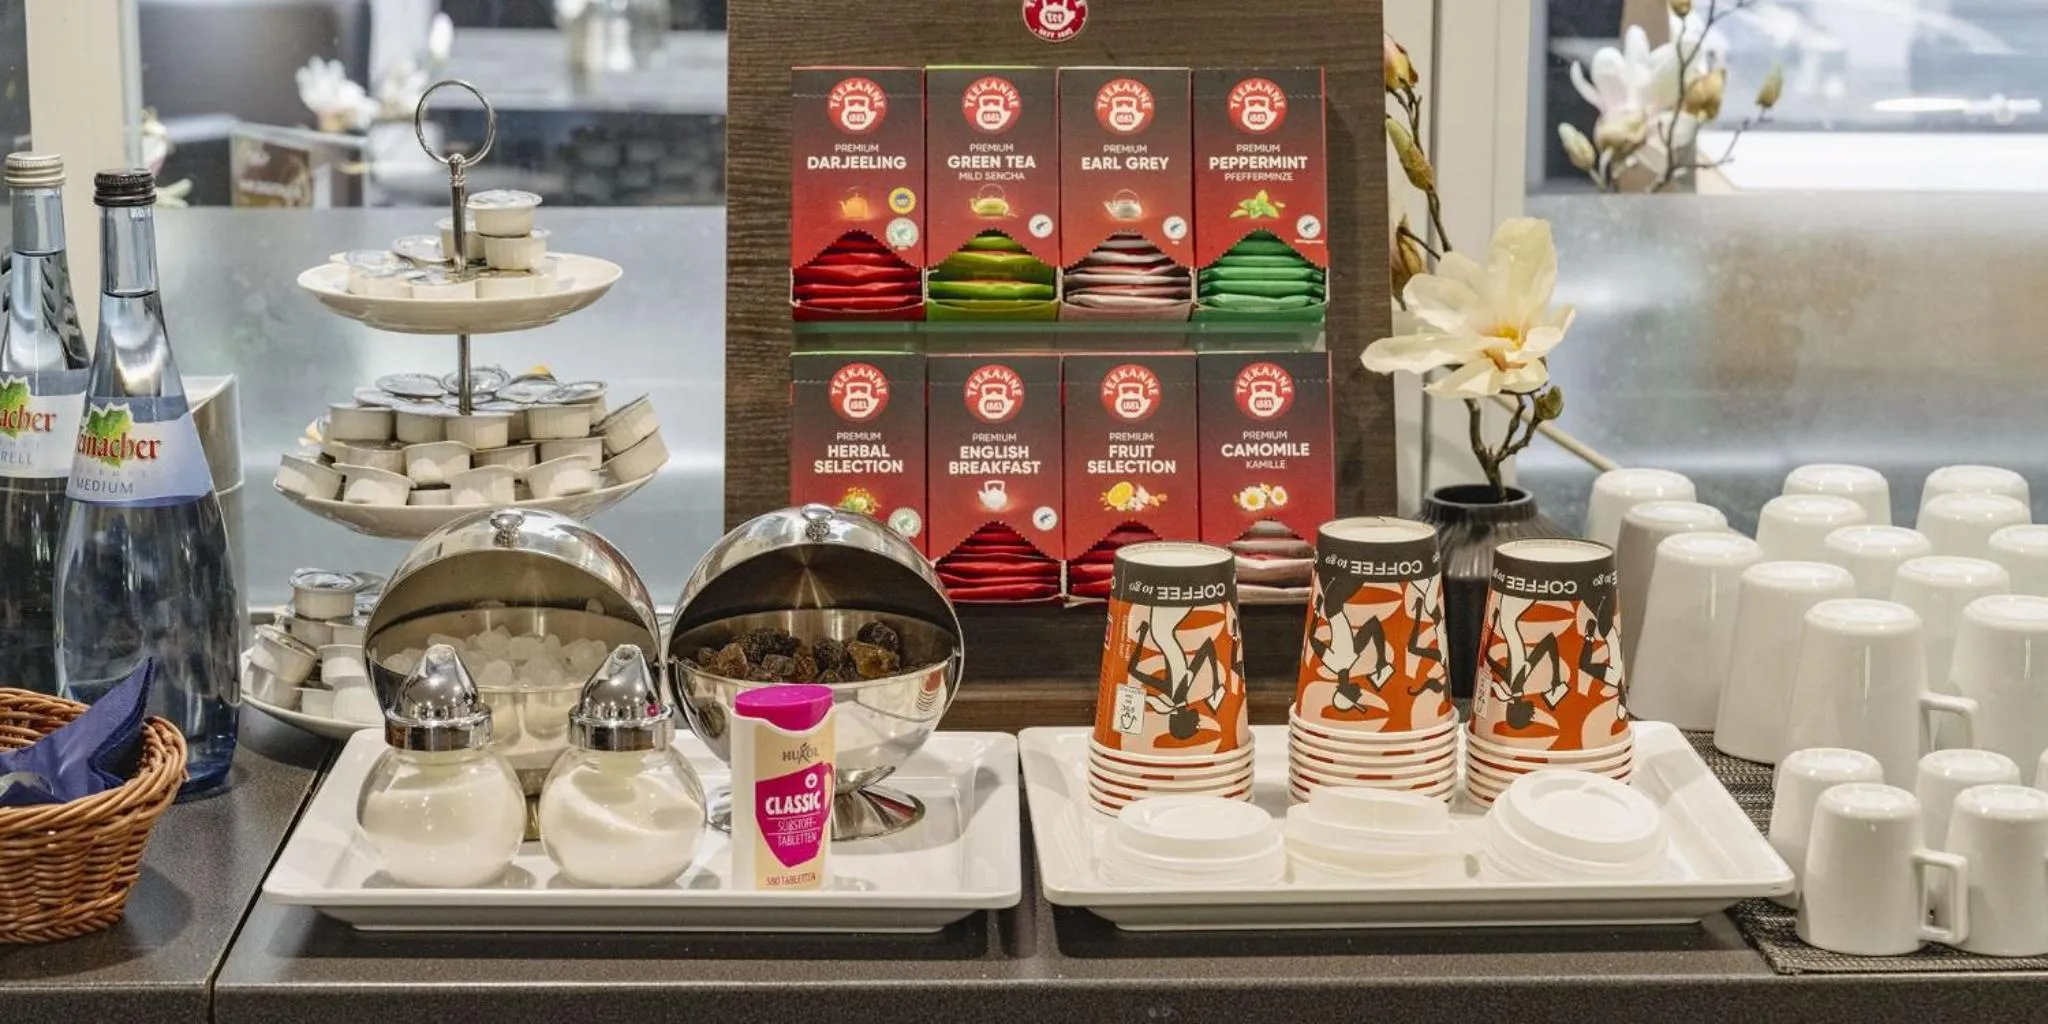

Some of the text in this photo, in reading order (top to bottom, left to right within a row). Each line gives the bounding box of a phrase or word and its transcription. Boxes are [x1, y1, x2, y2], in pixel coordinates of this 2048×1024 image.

[829, 81, 885, 109] TEEKANNE
[964, 80, 1020, 109] TEEKANNE
[1098, 82, 1153, 110] TEEKANNE
[1230, 81, 1286, 109] TEEKANNE
[834, 143, 879, 153] PREMIUM
[969, 143, 1014, 152] PREMIUM
[1103, 144, 1148, 154] PREMIUM
[1236, 143, 1281, 153] PREMIUM
[807, 155, 907, 170] DARJEELING
[947, 155, 1036, 169] GREEN TEA
[1081, 156, 1170, 170] EARL GREY
[1209, 155, 1308, 170] PEPPERMINT
[958, 171, 1026, 181] MILD SENCHA
[1224, 172, 1294, 181] PFEFFERMINZE
[831, 367, 887, 395] TEEKANNE
[966, 369, 1023, 397] TEEKANNE
[1103, 368, 1159, 396] TEEKANNE
[1236, 366, 1292, 395] TEEKANNE
[836, 431, 882, 440] PREMIUM
[972, 432, 1017, 442] PREMIUM
[1109, 432, 1154, 441] PREMIUM
[1243, 431, 1288, 440] PREMIUM
[827, 444, 890, 458] HERBAL
[960, 445, 1029, 459] ENGLISH
[1109, 444, 1154, 458] FRUIT
[1221, 443, 1310, 458] CAMOMILE
[814, 459, 903, 473] SELECTION
[948, 460, 1041, 474] BREAKFAST
[1087, 459, 1176, 473] SELECTION
[1246, 460, 1286, 469] KAMILLE
[76, 477, 134, 494] MEDIUM
[1325, 553, 1338, 566] go
[1337, 560, 1348, 569] to
[1350, 560, 1423, 575] COFFEE
[1128, 580, 1142, 592] go
[1506, 575, 1578, 594] COFFEE
[1592, 574, 1604, 587] go
[1142, 586, 1154, 595] to
[1156, 582, 1226, 600] COFFEE
[765, 790, 821, 815] CLASSIC
[777, 831, 817, 848] TABLETTEN
